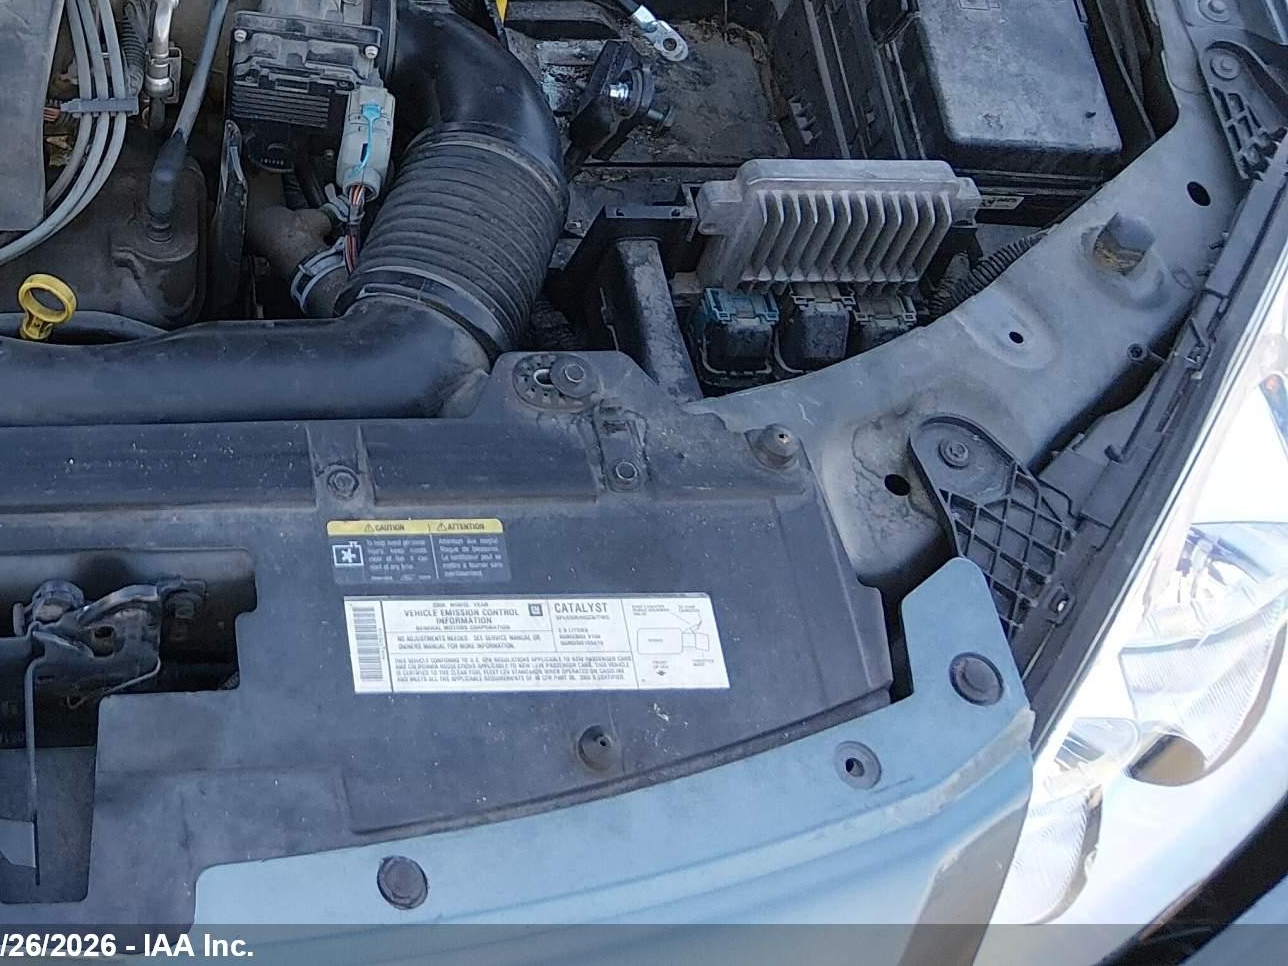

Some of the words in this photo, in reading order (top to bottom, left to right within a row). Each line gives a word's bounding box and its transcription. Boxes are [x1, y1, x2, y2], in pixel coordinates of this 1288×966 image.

[375, 523, 405, 531] CAUTION
[447, 522, 485, 530] ATTENTION
[554, 602, 608, 613] CATALYST
[403, 609, 438, 617] VEHICLE
[440, 609, 479, 617] EMISSION
[482, 608, 520, 616] CONTROL
[436, 616, 493, 625] INFORMATION
